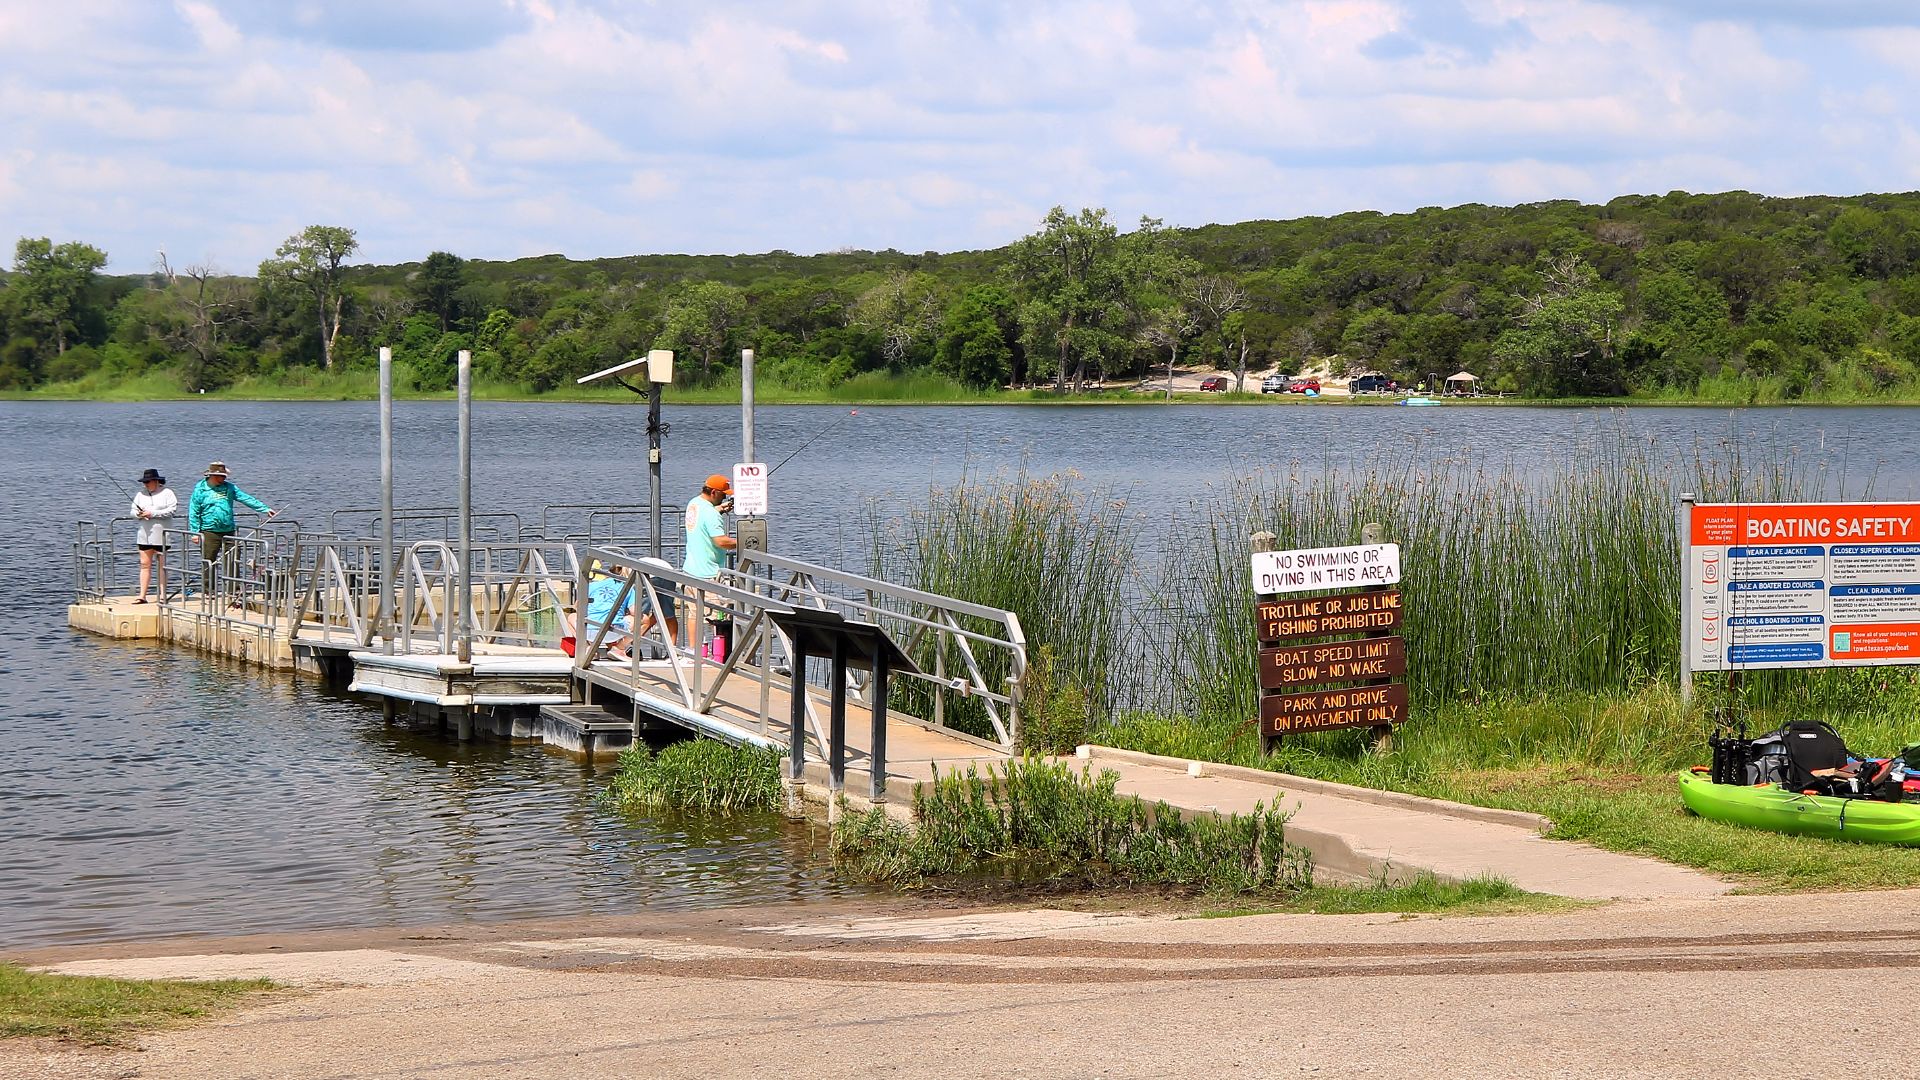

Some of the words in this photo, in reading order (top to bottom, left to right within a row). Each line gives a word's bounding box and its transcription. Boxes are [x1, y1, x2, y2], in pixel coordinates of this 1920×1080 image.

[741, 467, 760, 476] NO
[1748, 518, 1830, 537] BOATING
[1836, 518, 1911, 536] SAFETY
[1276, 556, 1292, 569] NO
[1297, 552, 1358, 568] SWIMMING
[1363, 550, 1379, 563] OR
[1263, 572, 1304, 588] DIVING
[1311, 571, 1322, 583] IN
[1327, 568, 1355, 582] THIS
[1361, 566, 1393, 579] AREA
[1260, 602, 1322, 620] TROTLINE
[1326, 600, 1342, 614] OR
[1347, 598, 1368, 612] JUG
[1373, 594, 1401, 610] LINE
[1269, 620, 1318, 636] FISHING
[1322, 612, 1394, 631] PROHIBITED
[1275, 650, 1309, 666] BOAT
[1314, 647, 1352, 662] SPEED
[1357, 643, 1391, 658] LIMIT
[1854, 643, 1909, 652] tpwd.texas.gov/boat
[1283, 666, 1317, 682] SLOW
[1330, 664, 1344, 678] NO
[1350, 660, 1386, 675] WAKE
[1284, 697, 1317, 712] PARK
[1323, 695, 1346, 709] AND
[1352, 690, 1387, 706] DRIVE
[1275, 716, 1290, 731] ON
[1295, 709, 1362, 728] PAVEMENT
[1368, 705, 1398, 720] ONLY
